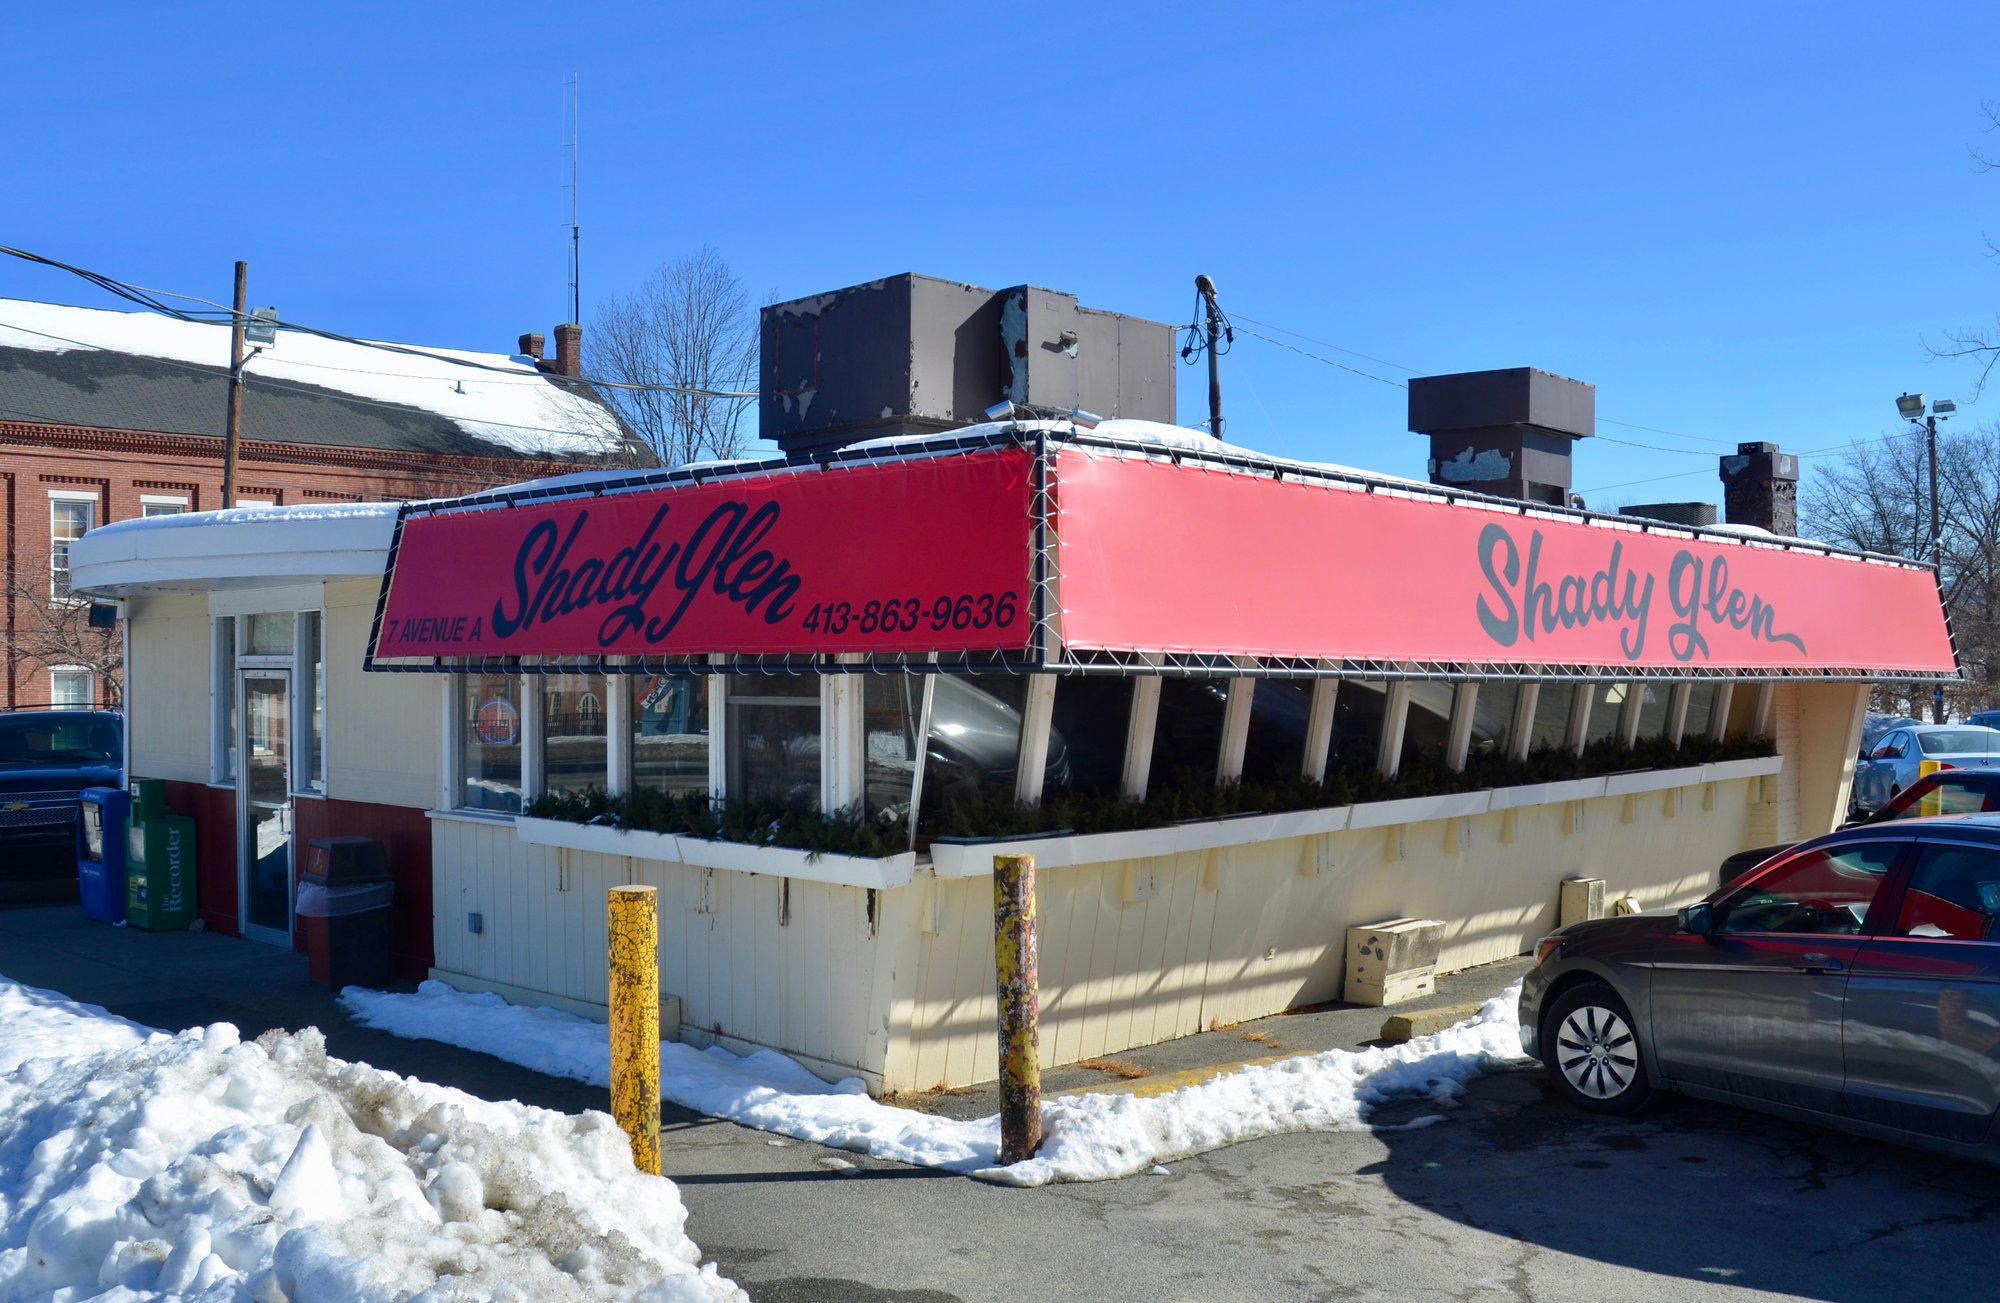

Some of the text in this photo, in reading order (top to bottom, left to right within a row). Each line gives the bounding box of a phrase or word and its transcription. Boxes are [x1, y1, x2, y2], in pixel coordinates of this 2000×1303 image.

[492, 503, 680, 647] Shady
[802, 592, 1017, 634] 413-863-9636
[1476, 523, 1654, 661] Shady
[387, 617, 482, 643] 7 AVENUE A
[166, 827, 181, 912] Recorder
